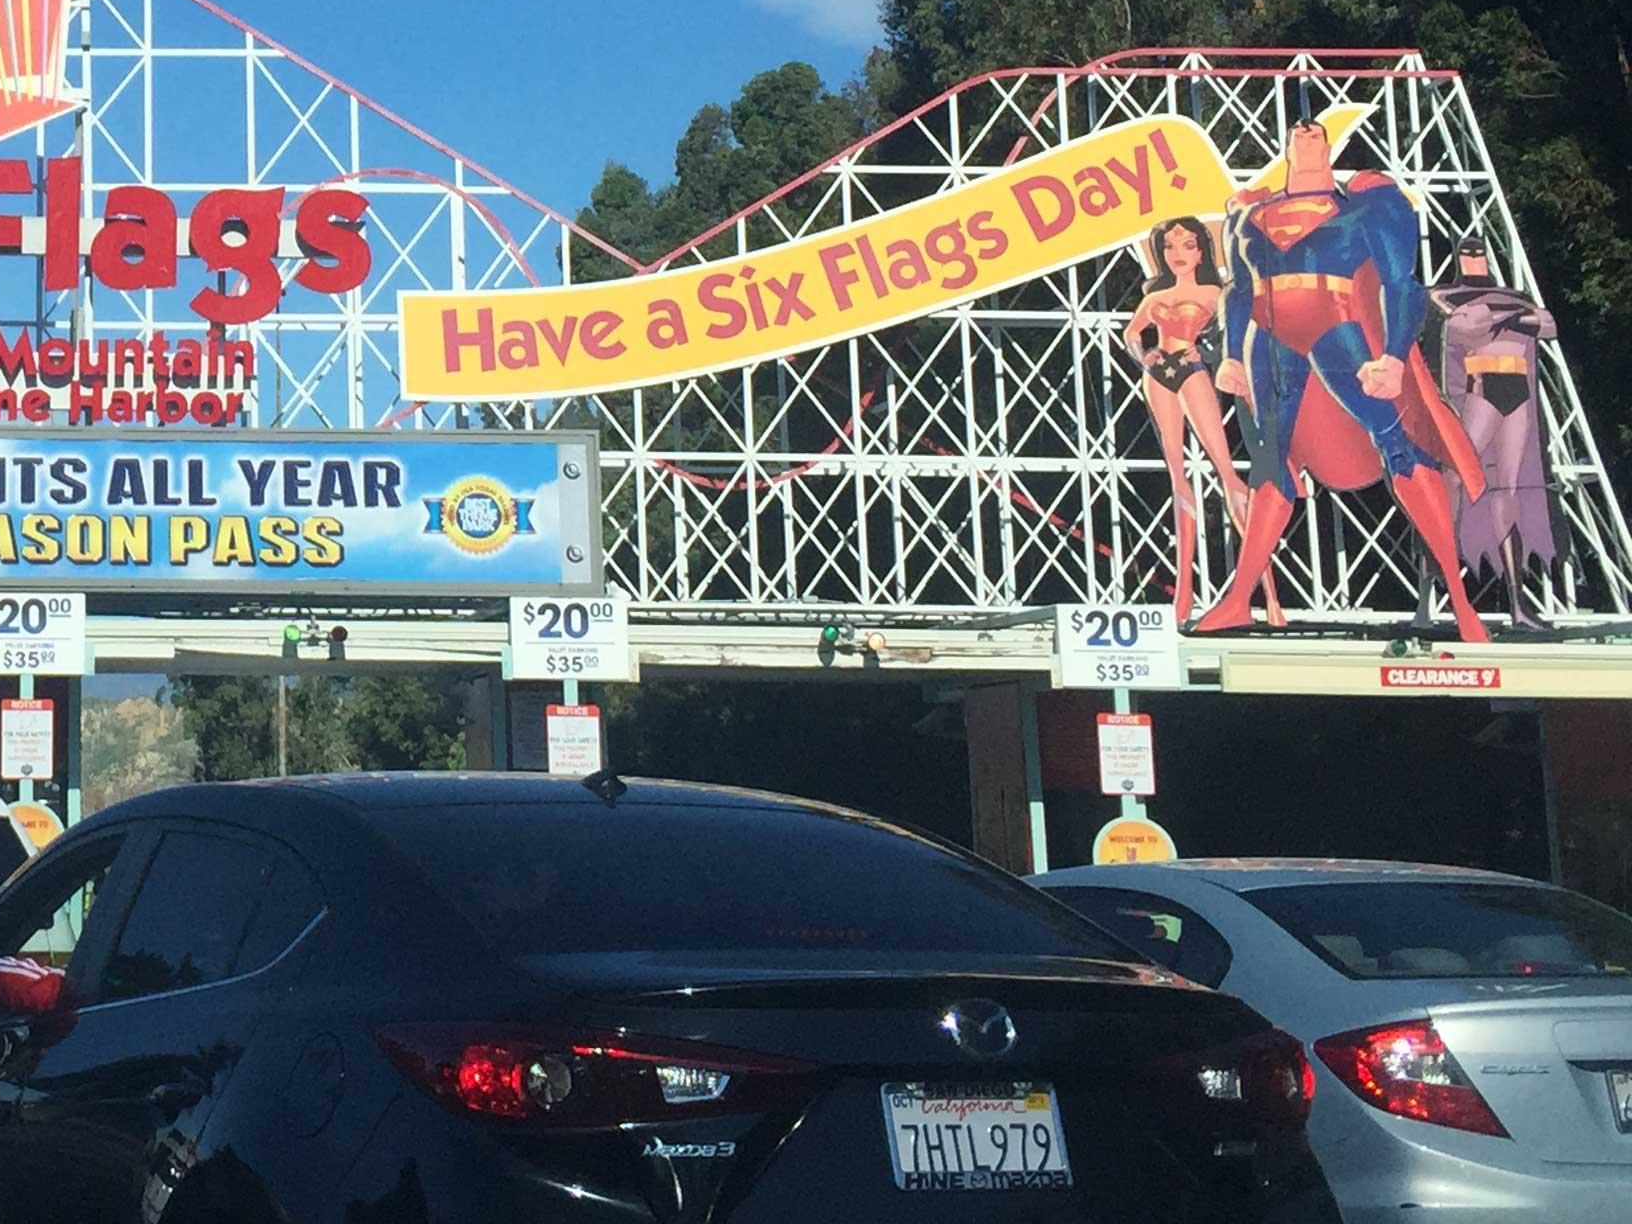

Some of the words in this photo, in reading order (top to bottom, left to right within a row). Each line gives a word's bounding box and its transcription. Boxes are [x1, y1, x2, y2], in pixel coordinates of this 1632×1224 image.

[441, 306, 625, 374] Have
[646, 298, 689, 351] a
[696, 265, 817, 342] Six
[818, 208, 1009, 313] Flags
[1010, 128, 1188, 244] Day!
[68, 378, 245, 426] Harbor
[106, 457, 217, 508] ALL
[237, 458, 402, 510] YEAR
[169, 514, 345, 567] PASS
[1388, 669, 1479, 686] CLEARANCE
[892, 1095, 914, 1109] OCT
[921, 1098, 1027, 1122] California
[900, 1123, 1051, 1172] 7HTL979
